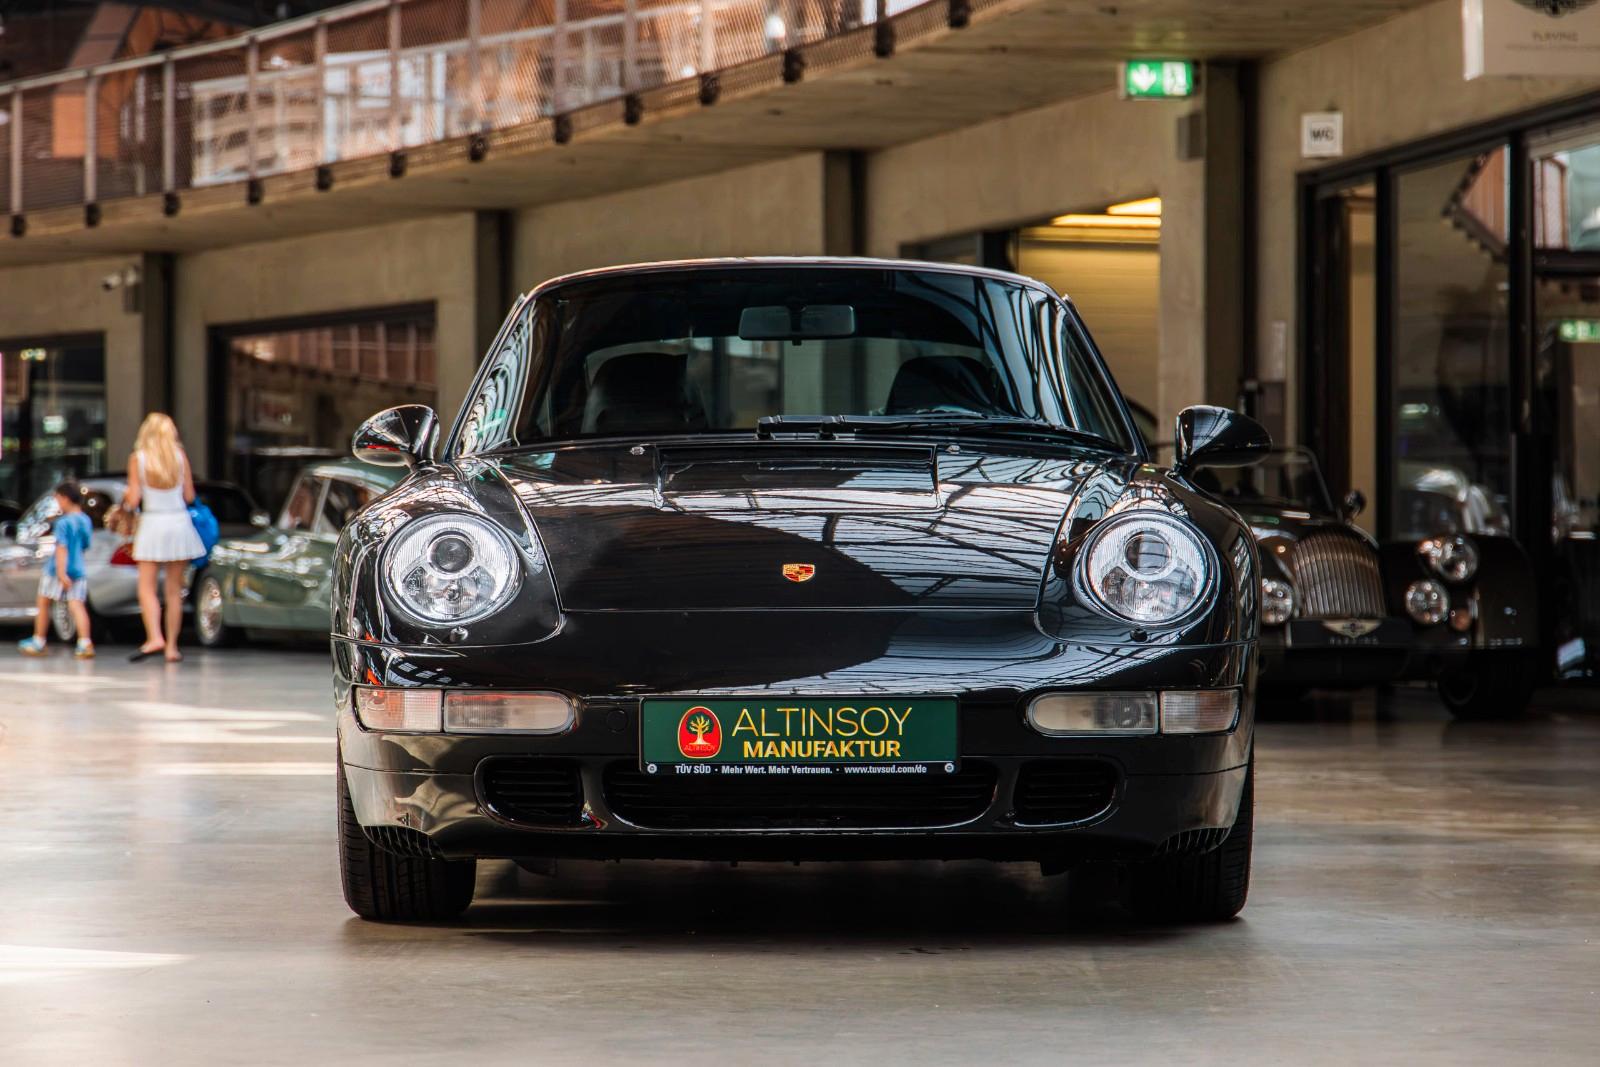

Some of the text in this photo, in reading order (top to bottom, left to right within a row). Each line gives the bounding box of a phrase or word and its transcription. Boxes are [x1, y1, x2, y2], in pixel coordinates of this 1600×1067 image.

[1310, 127, 1335, 142] WC
[731, 706, 913, 737] ALTINSOY
[743, 740, 901, 758] MANUFAKTUR
[675, 763, 928, 774] TÜV SÜD Mehr Wert. Mehr Vertrauen. www.tuvsud.com/de
